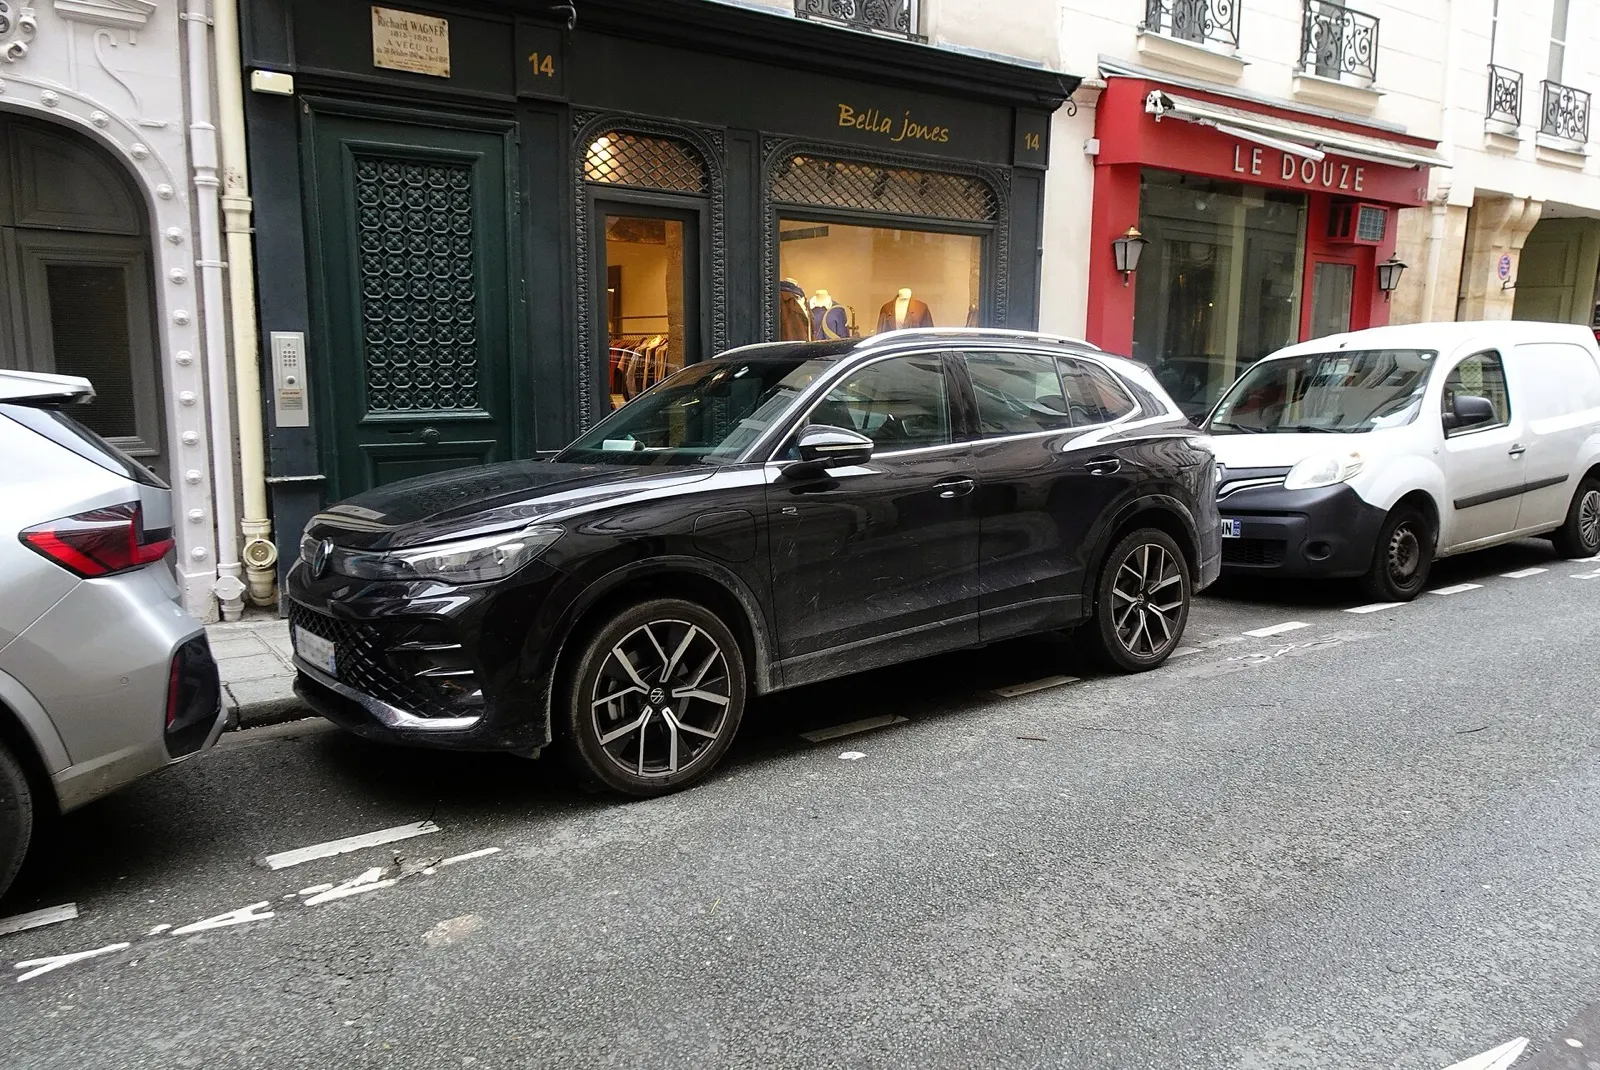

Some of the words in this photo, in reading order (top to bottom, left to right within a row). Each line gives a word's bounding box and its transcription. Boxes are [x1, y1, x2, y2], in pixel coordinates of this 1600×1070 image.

[377, 14, 408, 31] Richard
[410, 20, 445, 37] WAGNER
[425, 44, 439, 54] ICI
[528, 52, 555, 77] 14
[838, 103, 892, 134] Bella
[890, 110, 950, 143] jones
[1024, 132, 1040, 151] 14
[1233, 144, 1263, 176] LE
[1281, 153, 1365, 192] DOUZE
[1415, 187, 1428, 202] 12
